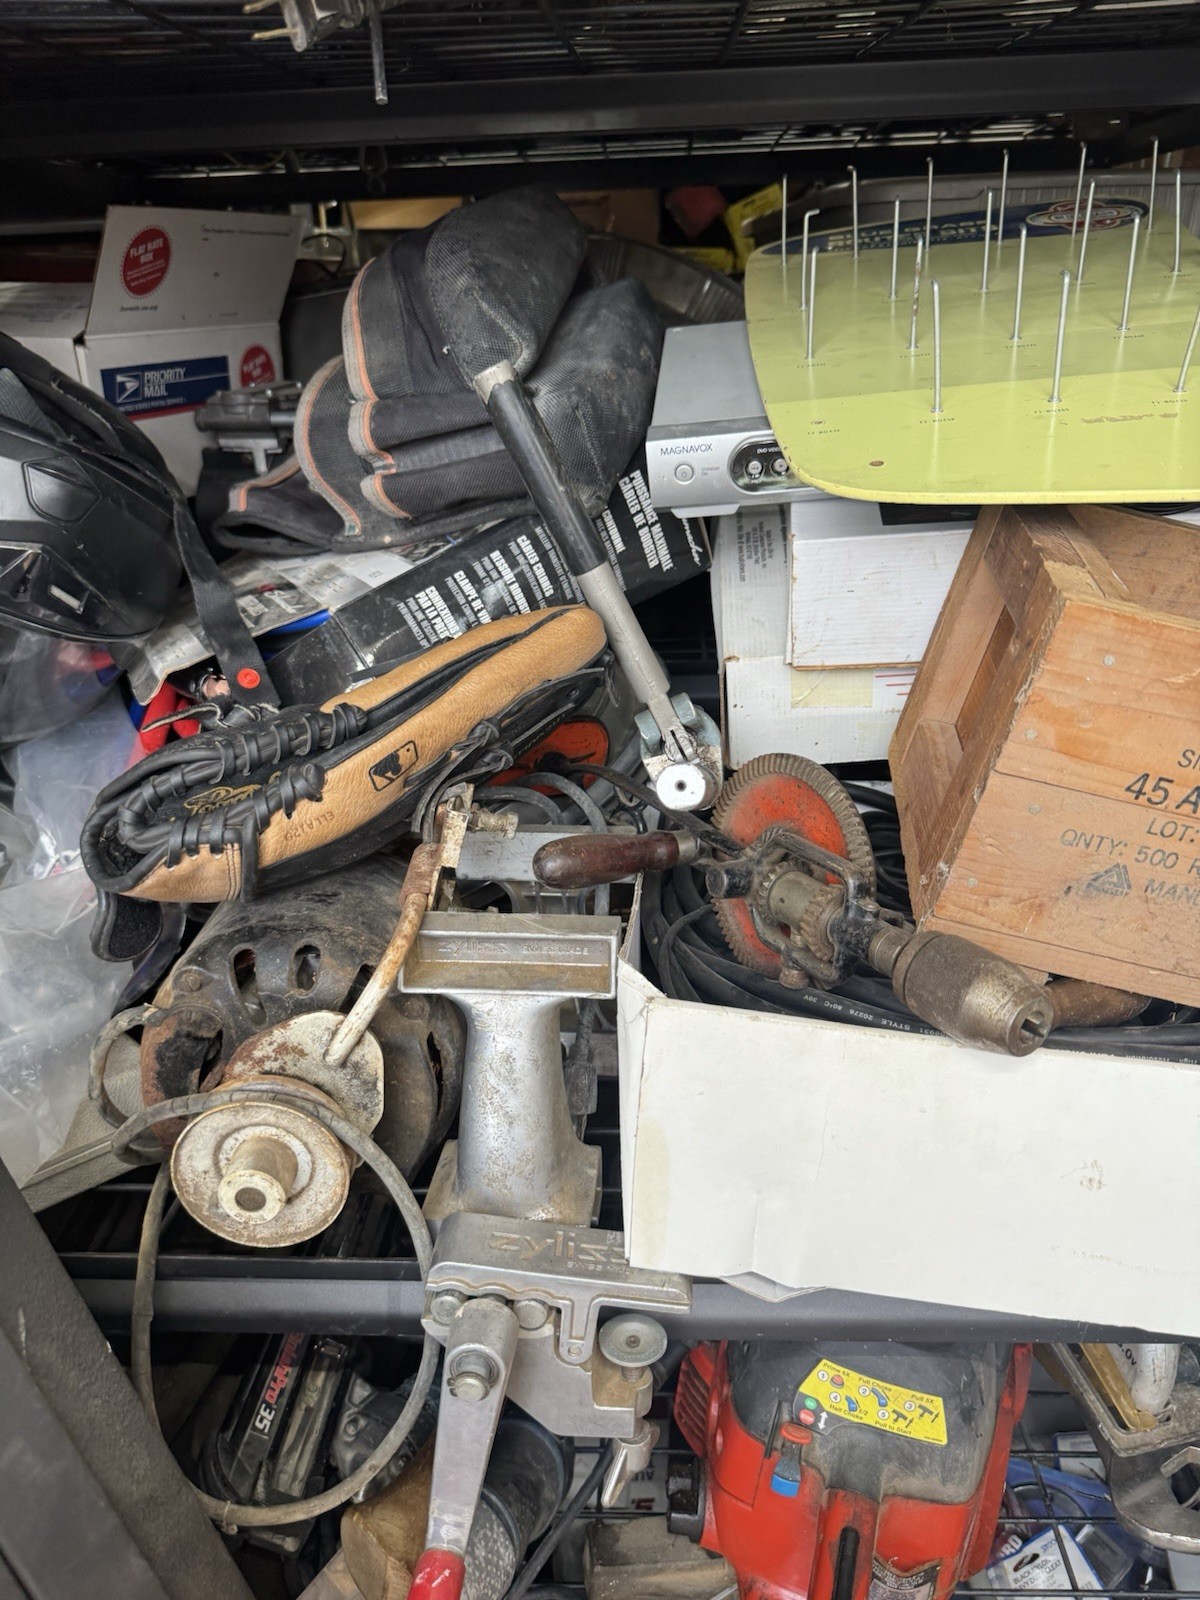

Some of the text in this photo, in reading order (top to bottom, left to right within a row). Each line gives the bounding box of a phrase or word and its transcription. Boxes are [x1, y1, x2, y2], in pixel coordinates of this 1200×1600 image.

[144, 368, 187, 384] PRIORITY
[144, 384, 168, 398] MAIL
[660, 443, 713, 455] MAGNAVOX
[631, 511, 646, 527] DE
[637, 524, 659, 568] BOOSTER
[648, 521, 674, 571] MAXIMALE
[489, 550, 516, 584] RESSORT
[453, 569, 478, 601] CLAMPE
[470, 597, 484, 611] DE
[405, 596, 419, 611] POUR
[414, 590, 432, 609] PAR
[425, 606, 438, 619] LA
[424, 585, 460, 634] CONNEXIONS
[1124, 772, 1176, 806] 45
[1146, 817, 1200, 843] LOT:
[1059, 828, 1129, 858] QNTY:
[1133, 845, 1179, 869] 500
[803, 994, 817, 1003] 30V
[880, 1017, 911, 1030] STYLE
[822, 1362, 843, 1375] Prime
[858, 1376, 893, 1392] Full Choke
[911, 1393, 924, 1401] Pull
[252, 1402, 277, 1432] 35
[829, 1404, 864, 1421] Half Choke
[858, 1408, 868, 1416] 1/2
[874, 1420, 888, 1428] Pull
[896, 1426, 912, 1436] Start
[1043, 1559, 1062, 1574] CLEAT
[1013, 1568, 1032, 1583] BLACK
